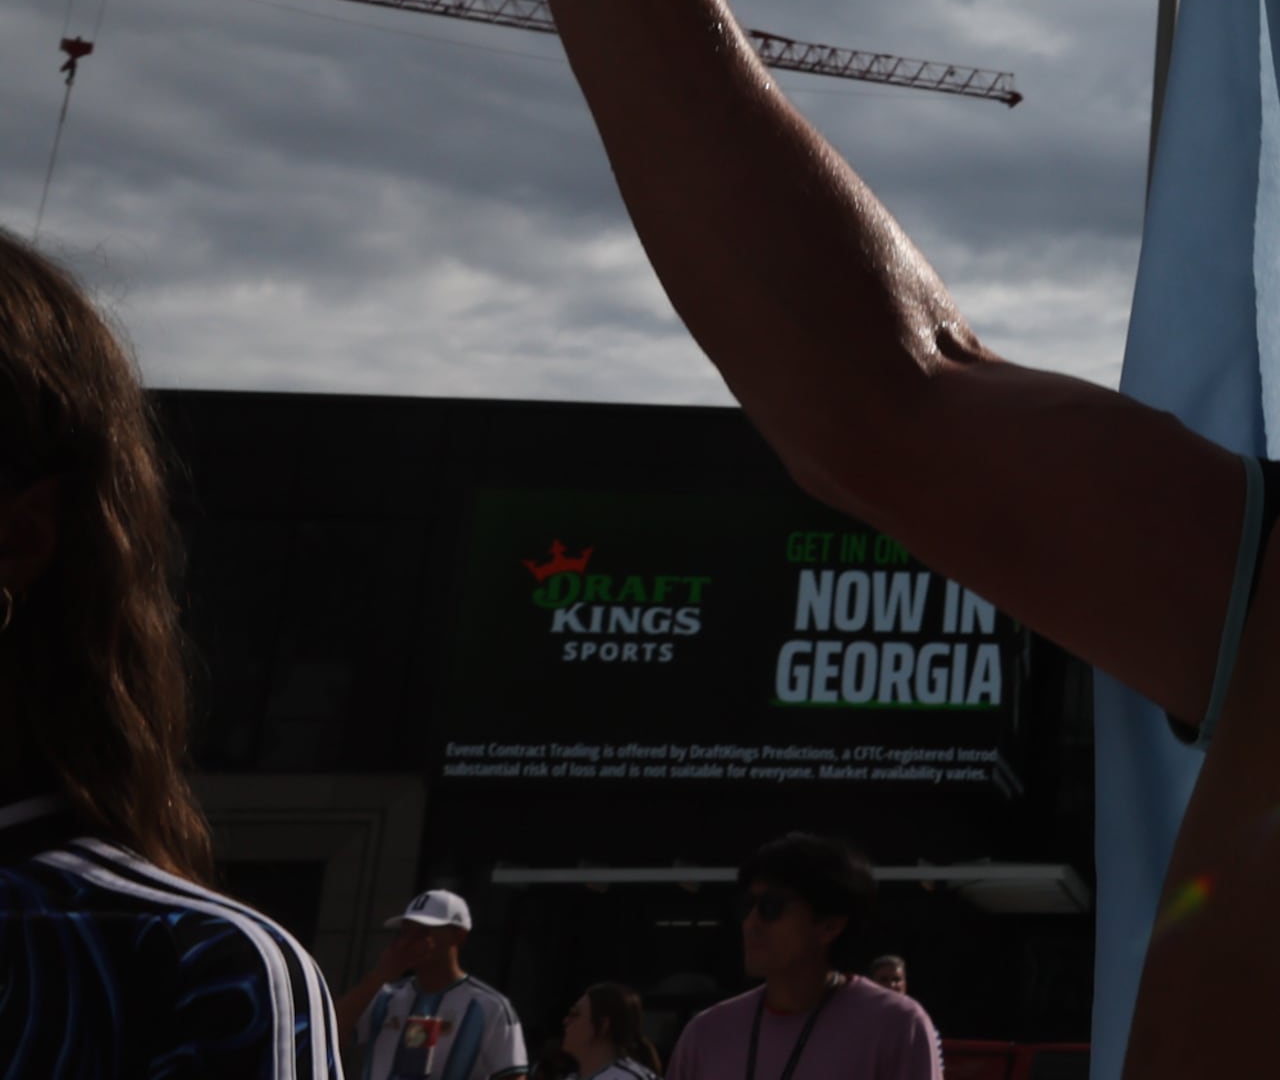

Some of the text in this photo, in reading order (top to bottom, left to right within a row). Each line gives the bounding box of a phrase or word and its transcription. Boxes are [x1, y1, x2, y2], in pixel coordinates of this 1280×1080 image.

[785, 531, 834, 563] GET
[840, 531, 868, 564] IN
[532, 572, 712, 608] DRAFT
[794, 569, 996, 635] NOW IN
[550, 601, 703, 636] KINGS
[561, 640, 675, 663] SPORTS
[775, 639, 1003, 706] GEORGIA
[446, 741, 486, 758] Event
[487, 741, 546, 759] Contract
[550, 742, 600, 762] Trading
[603, 743, 614, 758] is
[616, 742, 667, 760] offered
[670, 744, 688, 763] by
[690, 744, 759, 763] DraftKings
[443, 761, 989, 785] substantial risk of loss and is not suitable for everyone. Market availability varies.
